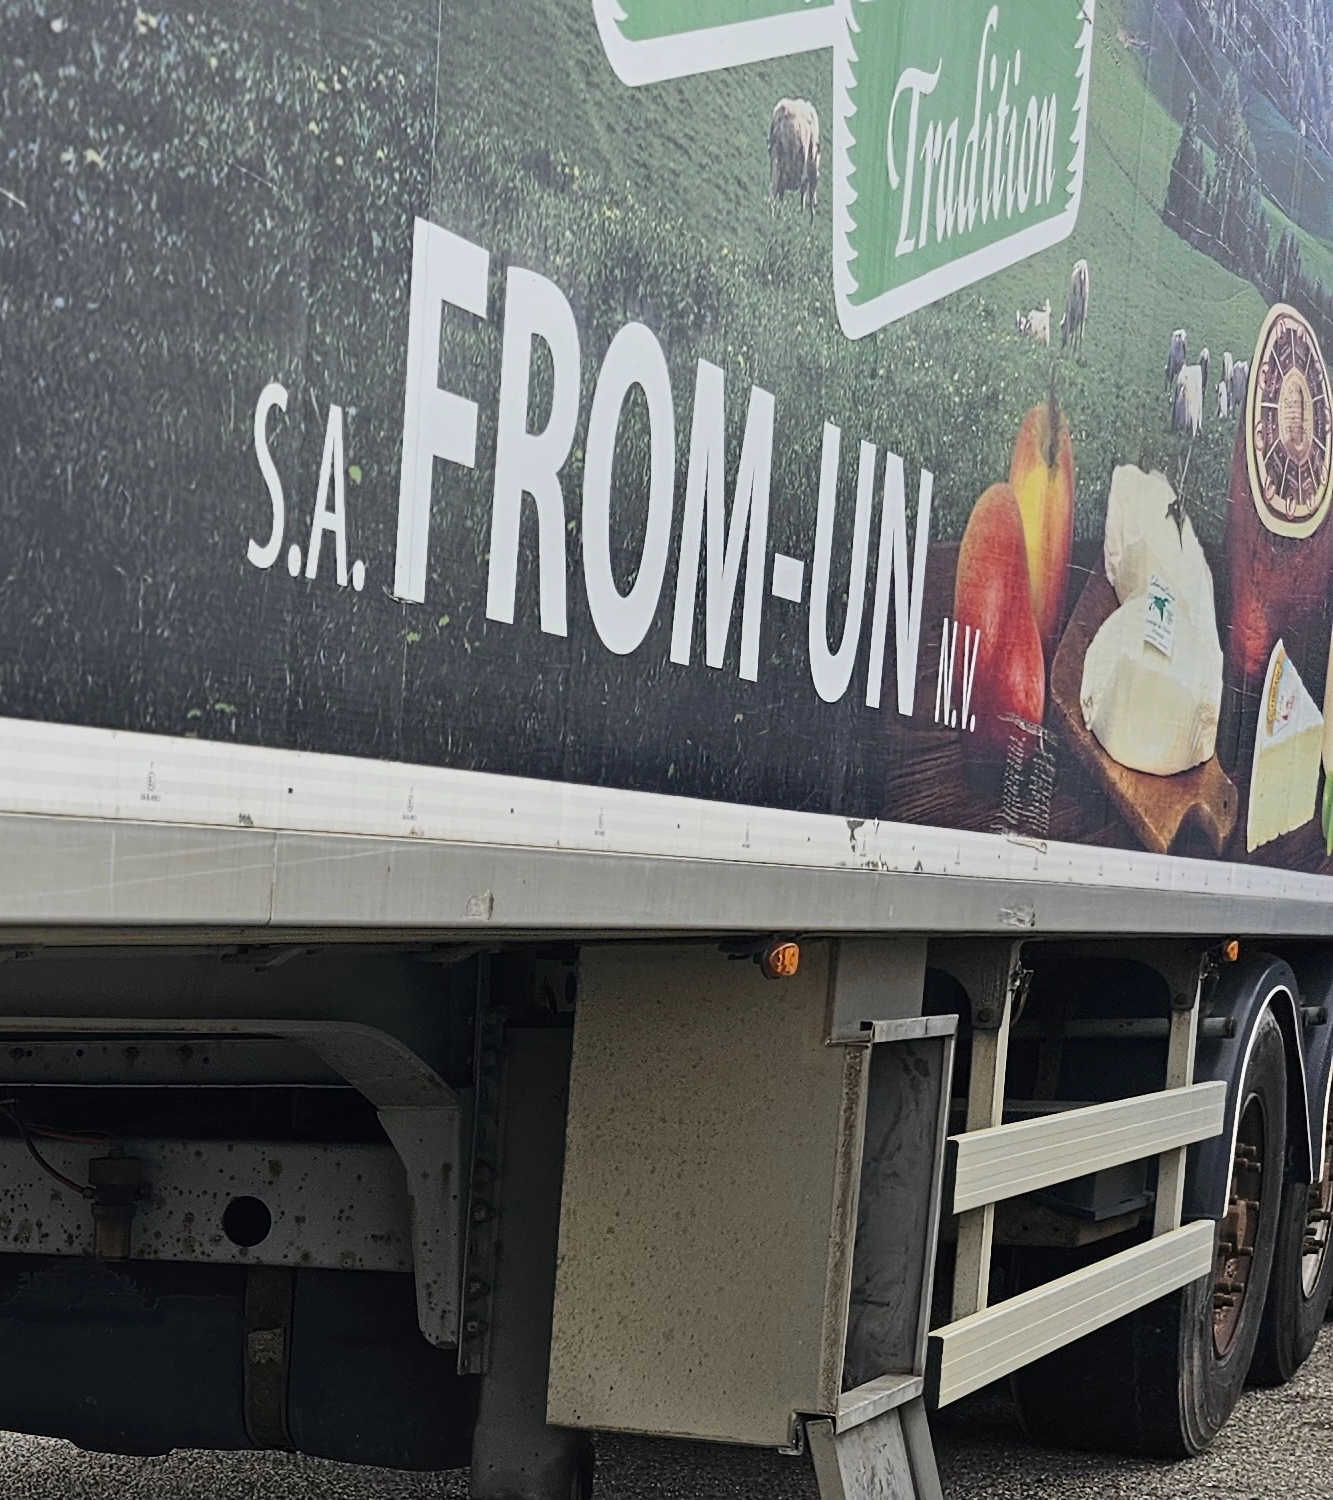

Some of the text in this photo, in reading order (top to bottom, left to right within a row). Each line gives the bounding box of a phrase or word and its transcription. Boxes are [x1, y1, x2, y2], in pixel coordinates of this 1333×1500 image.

[887, 5, 1056, 257] Tradition
[247, 217, 980, 733] S.A. FROM-UN N.V.
